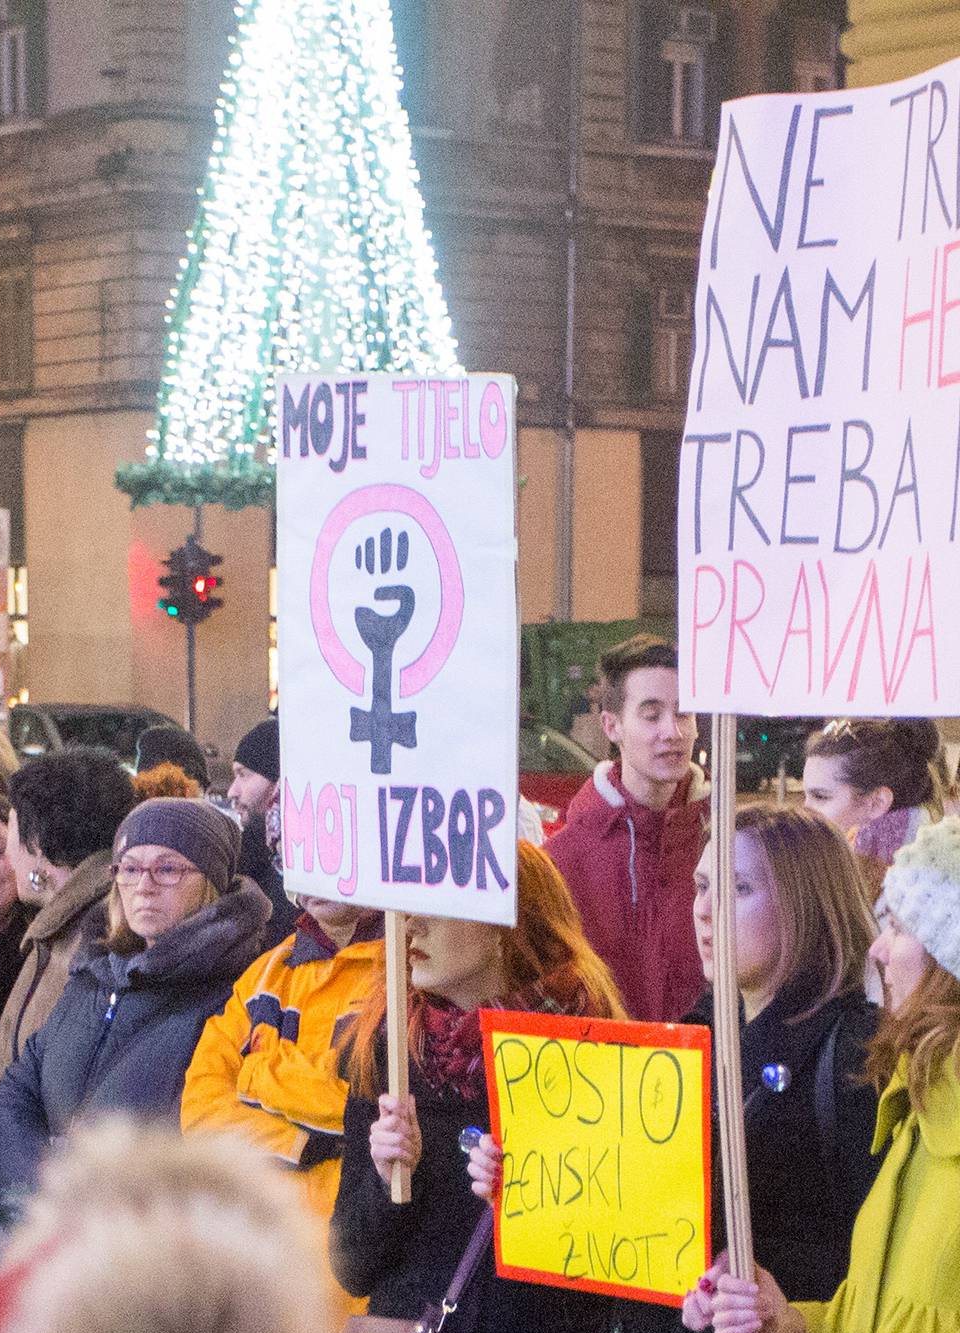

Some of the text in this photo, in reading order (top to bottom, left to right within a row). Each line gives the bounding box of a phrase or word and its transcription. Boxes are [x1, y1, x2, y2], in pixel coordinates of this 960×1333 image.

[710, 80, 960, 270] NE TR
[698, 257, 876, 411] NAM
[282, 379, 507, 479] MOJE TIJELO
[684, 416, 922, 554] TREBA
[691, 551, 938, 706] PRAVNA
[283, 776, 510, 897] MOJ IZBOR
